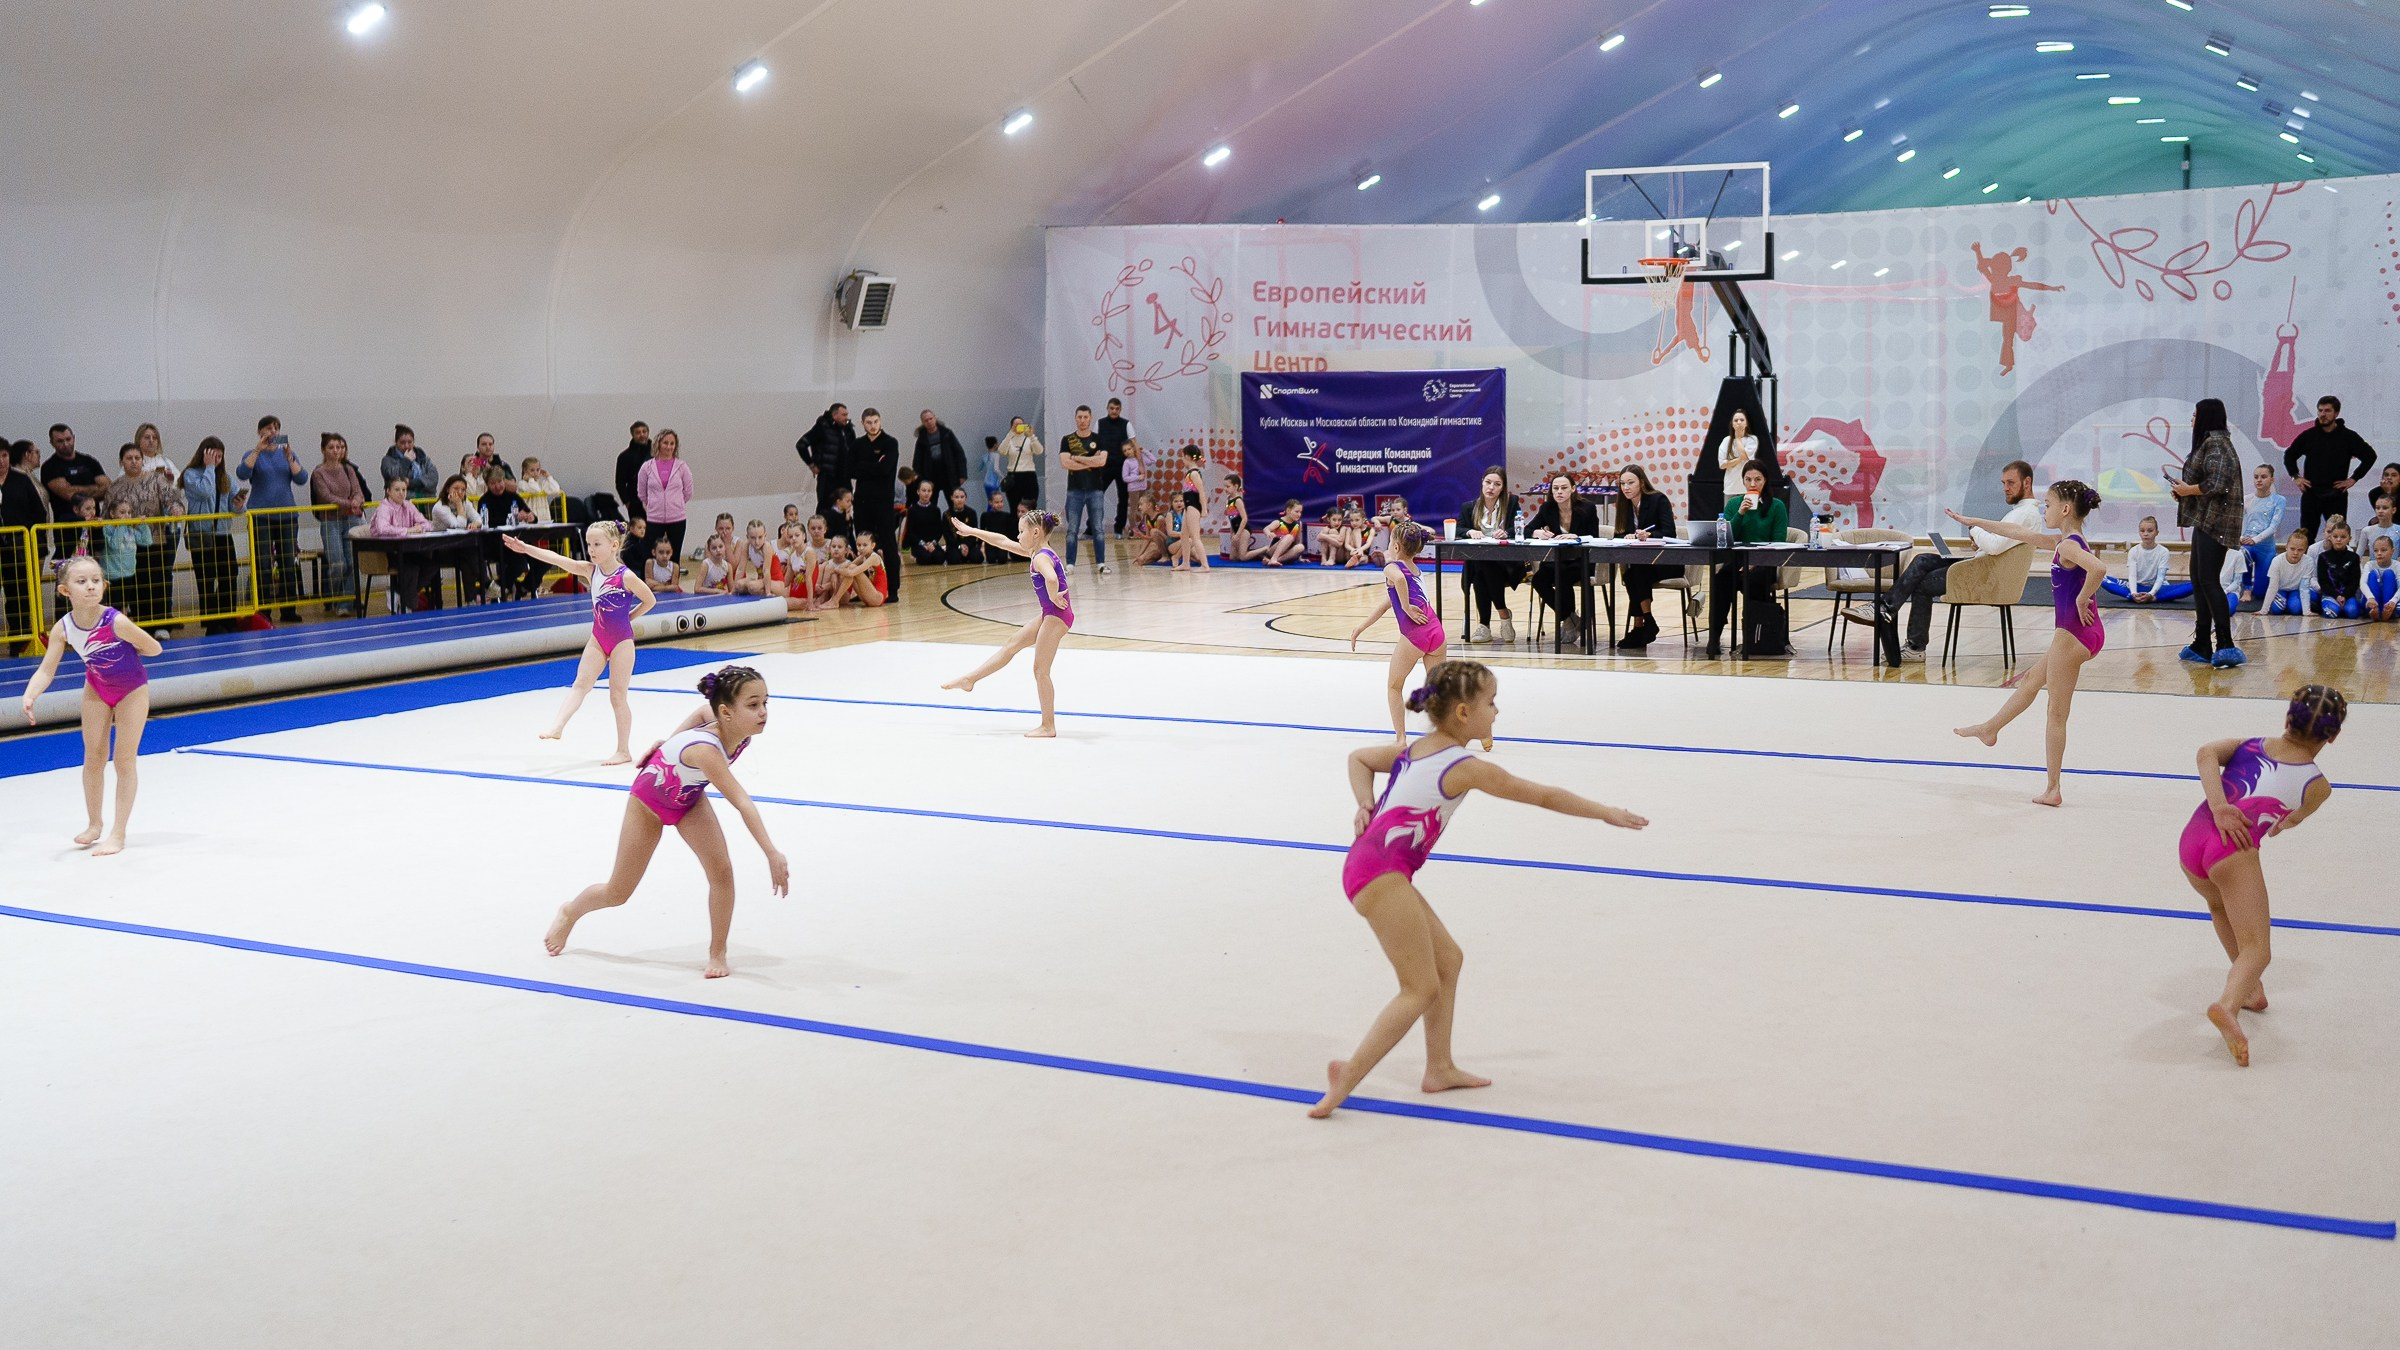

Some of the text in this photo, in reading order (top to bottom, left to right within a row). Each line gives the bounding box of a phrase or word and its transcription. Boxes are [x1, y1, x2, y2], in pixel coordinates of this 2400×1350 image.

[1253, 281, 1426, 308] Европейский
[1253, 316, 1472, 342] Гимнастический
[1253, 350, 1328, 372] Центр
[1272, 387, 1319, 395] СпортВилл
[1259, 416, 1482, 429] Кубок Москвы и Московской области по Командной гимнастике
[1335, 447, 1432, 461] Федерация Командной
[1335, 462, 1418, 474] Гимнастики России
